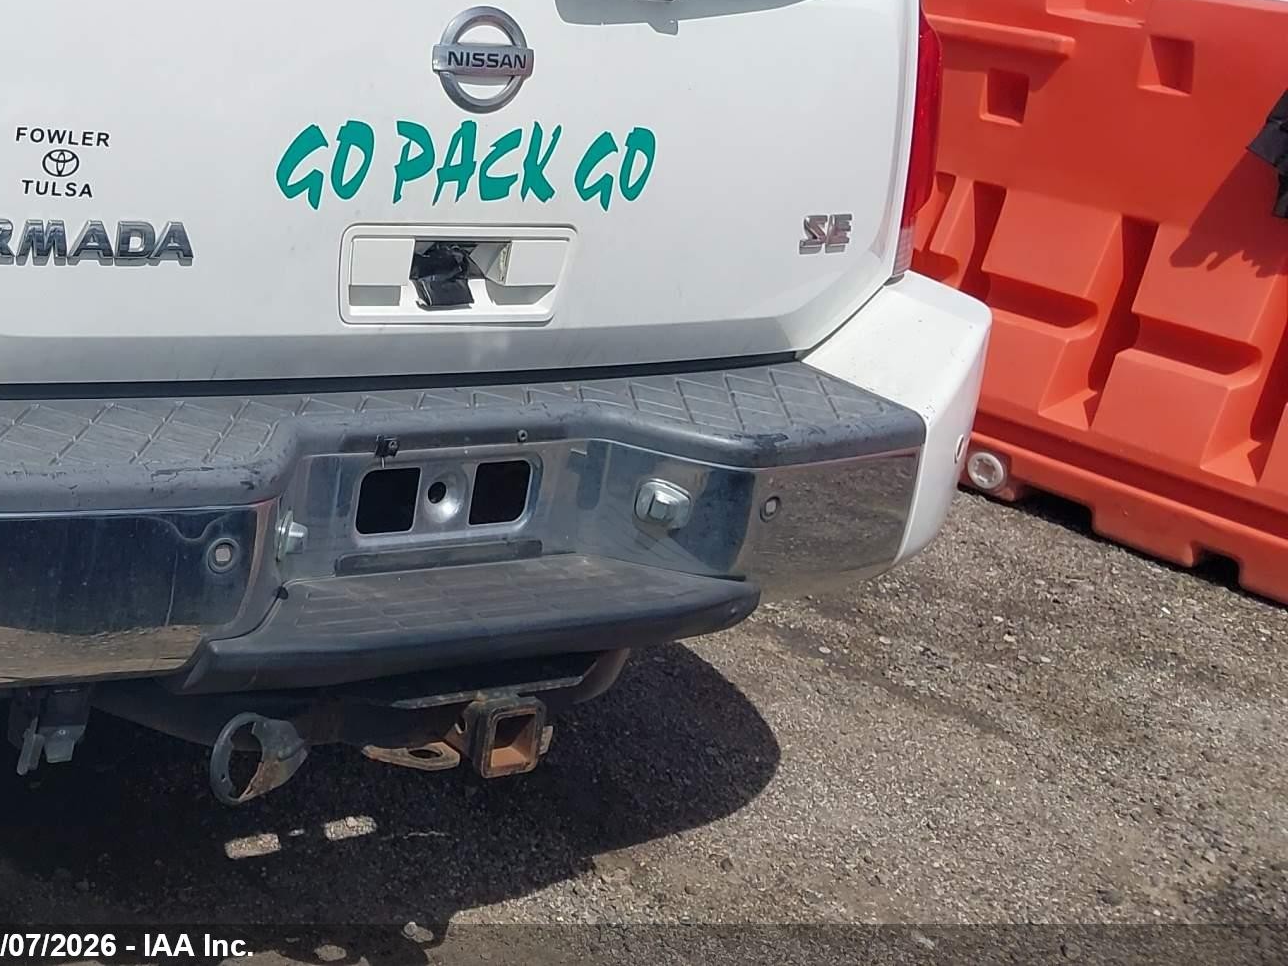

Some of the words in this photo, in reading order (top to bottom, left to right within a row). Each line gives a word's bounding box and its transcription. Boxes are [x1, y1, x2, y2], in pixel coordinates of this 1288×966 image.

[446, 50, 527, 70] NISSAN
[15, 127, 110, 147] FOWLER
[275, 118, 377, 210] GO
[392, 119, 563, 206] PACK
[574, 126, 657, 212] GO
[21, 179, 93, 198] TULSA
[798, 214, 853, 255] SE
